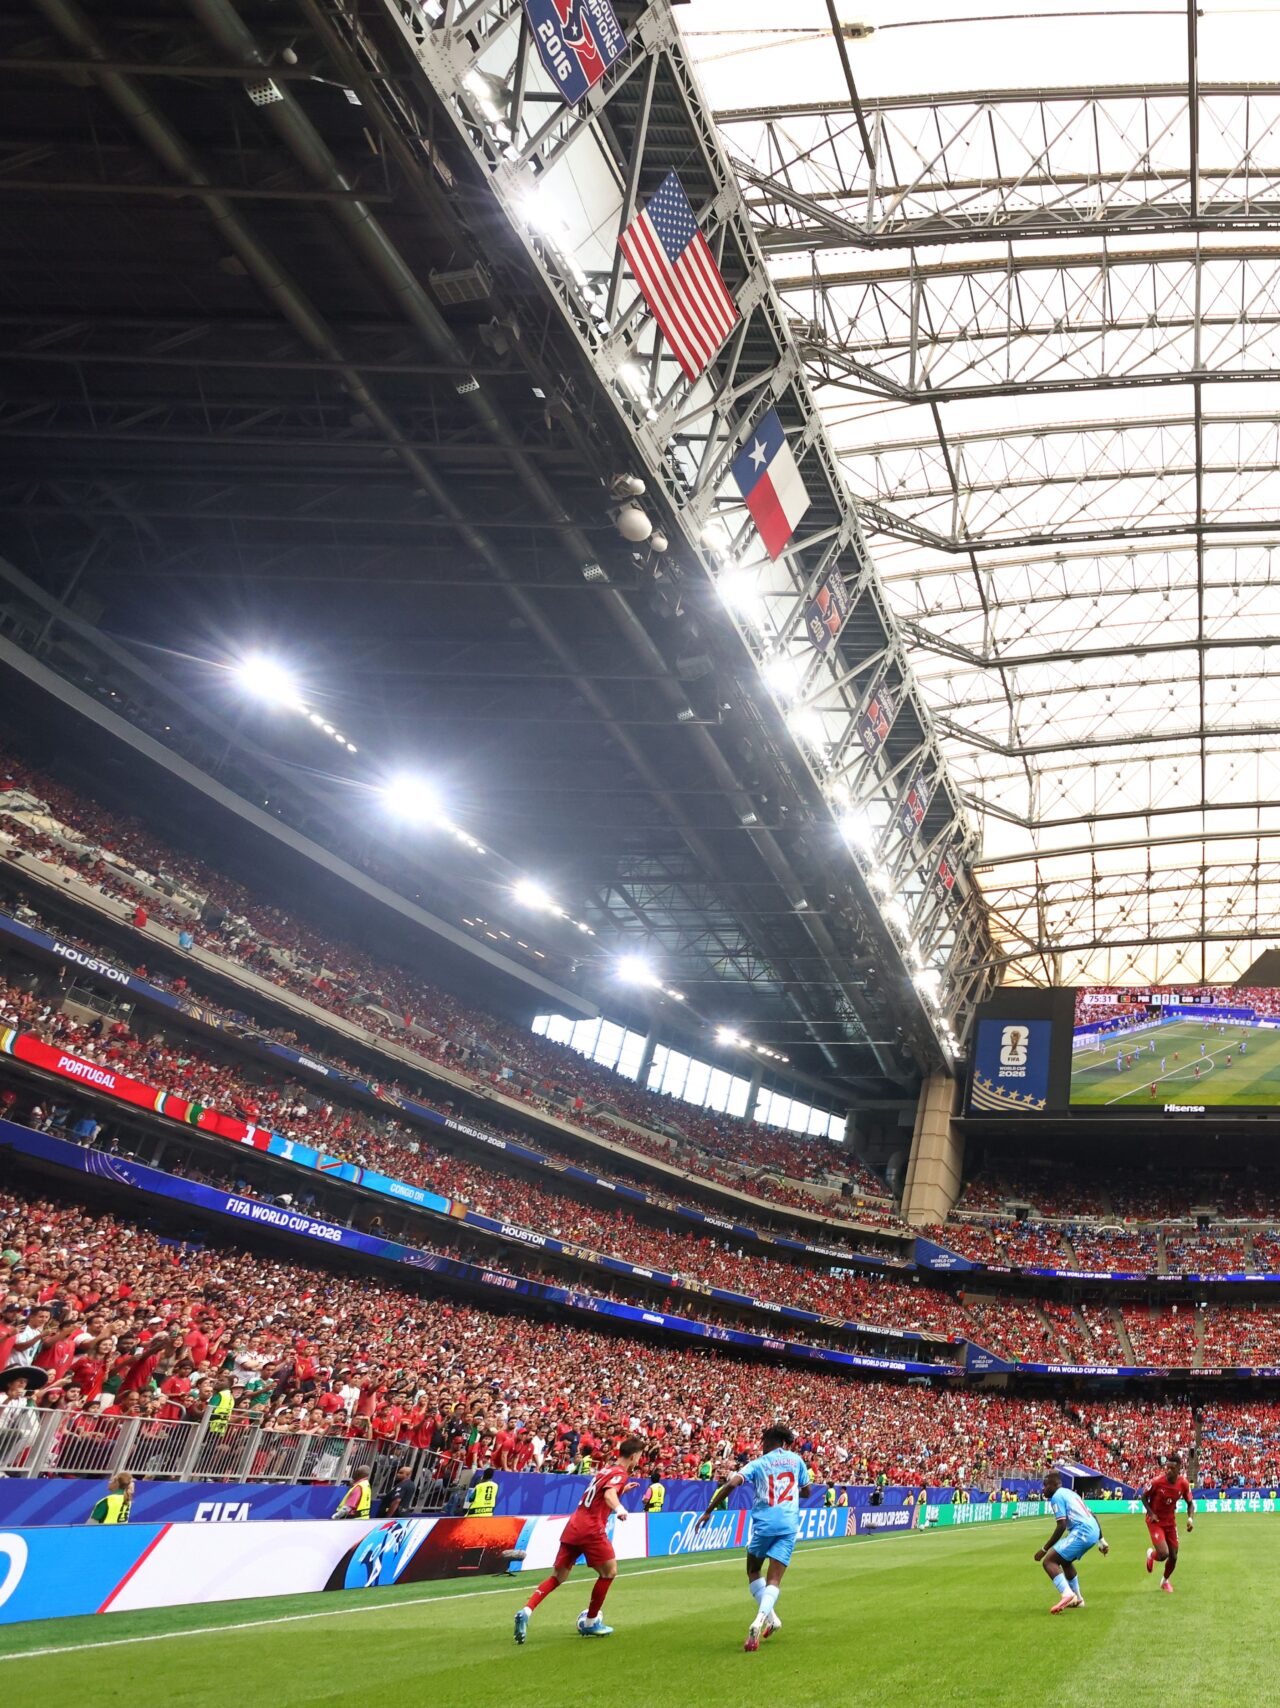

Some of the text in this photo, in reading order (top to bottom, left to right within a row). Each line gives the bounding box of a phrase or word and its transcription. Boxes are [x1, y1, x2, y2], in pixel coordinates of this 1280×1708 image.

[588, 0, 617, 59] MPIONS
[537, 19, 573, 82] 2016
[52, 942, 130, 985] HOUSTON
[1089, 995, 1112, 1003] 75:31
[57, 1056, 116, 1089] PORTUGAL
[1164, 1104, 1205, 1114] Hisense
[241, 1125, 255, 1147] 1
[444, 1119, 507, 1149] FIFA WORLD CUP 2026
[280, 1141, 294, 1161] 1
[390, 1182, 425, 1203] CONGO DR
[225, 1198, 342, 1242] FIFA WORLD CUP 2026
[703, 1216, 733, 1231] HOUSTON
[501, 1225, 546, 1246] HOUSTON
[481, 1272, 518, 1290] HOUSTON
[752, 1300, 782, 1313] HOUSTON
[862, 1358, 879, 1368] WORLD
[1060, 1366, 1083, 1374] WORLD
[768, 1471, 795, 1507] 12
[1242, 1491, 1261, 1499] FIFA
[194, 1502, 251, 1521] FIFA
[860, 1512, 873, 1528] FIFA
[872, 1511, 888, 1527] WORLD
[887, 1511, 897, 1526] CUP
[895, 1510, 910, 1524] 2026
[669, 1511, 733, 1555] Michelob
[799, 1508, 838, 1538] ZERO
